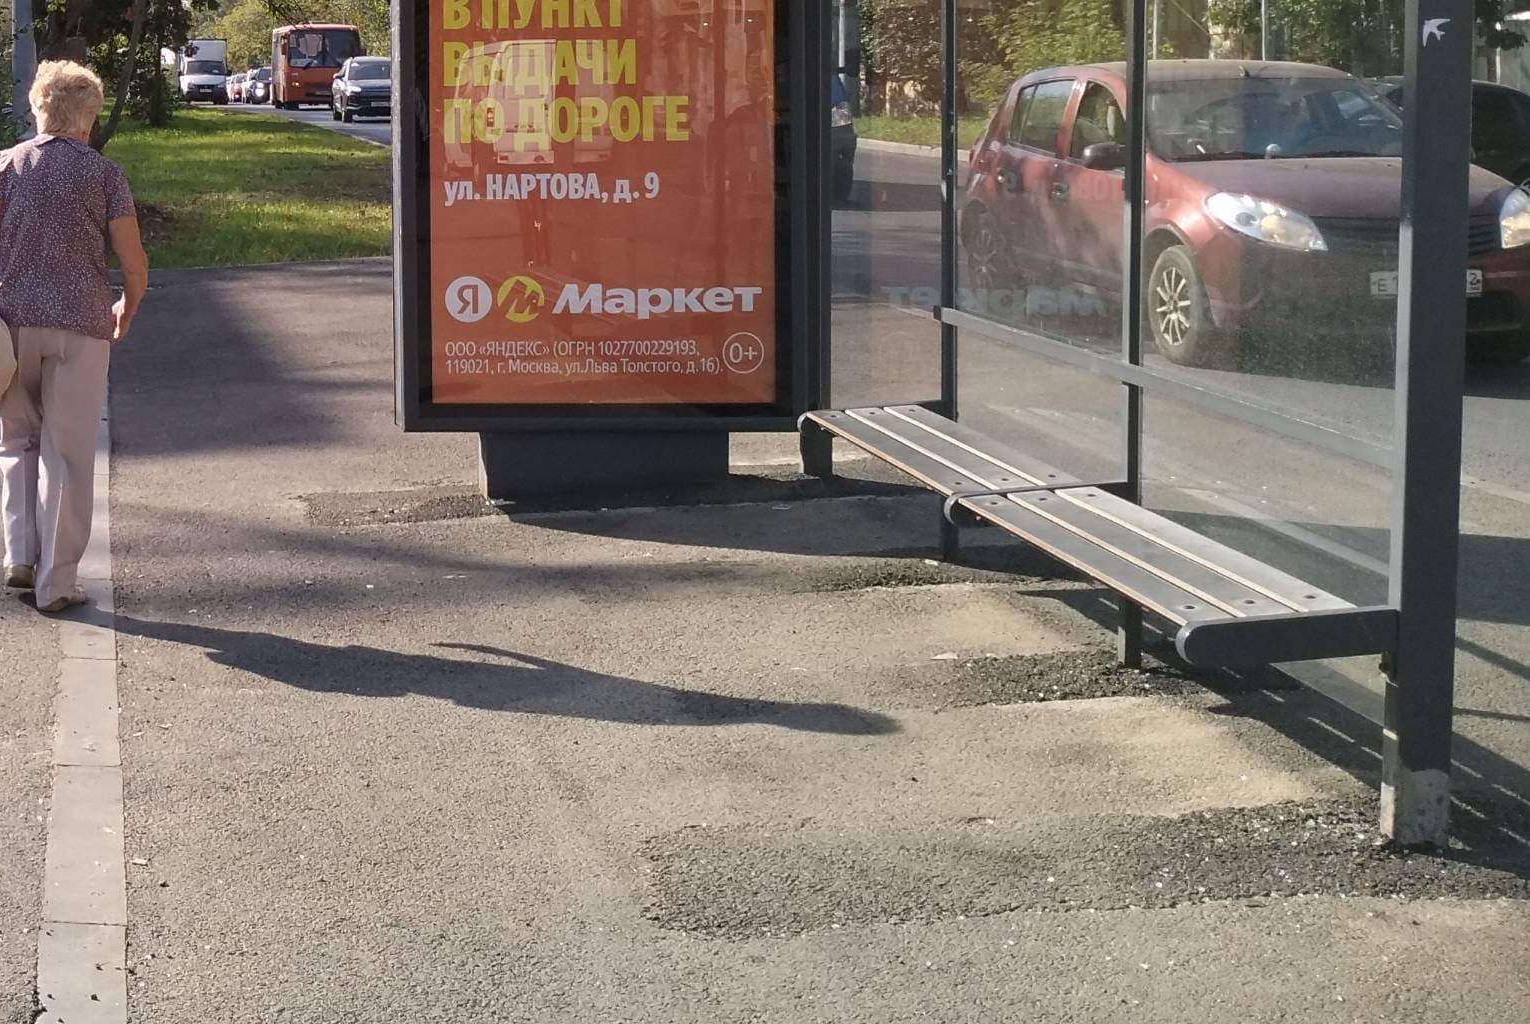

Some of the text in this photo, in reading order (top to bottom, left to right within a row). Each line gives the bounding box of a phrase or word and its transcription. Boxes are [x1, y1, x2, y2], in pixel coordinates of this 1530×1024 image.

[443, 38, 637, 97] ВЫДАЧИ
[443, 95, 690, 152] ПО ДОРОГЕ
[444, 171, 660, 207] ул. НАРТОВА, д. 9
[551, 282, 763, 320] Маркет
[445, 341, 476, 357] ООО
[479, 340, 550, 358] «ЯНДЕКС»
[553, 340, 595, 358] (ОГРН
[445, 359, 495, 375] 119021,
[620, 358, 684, 375] Толстого,
[729, 342, 758, 364] 0+
